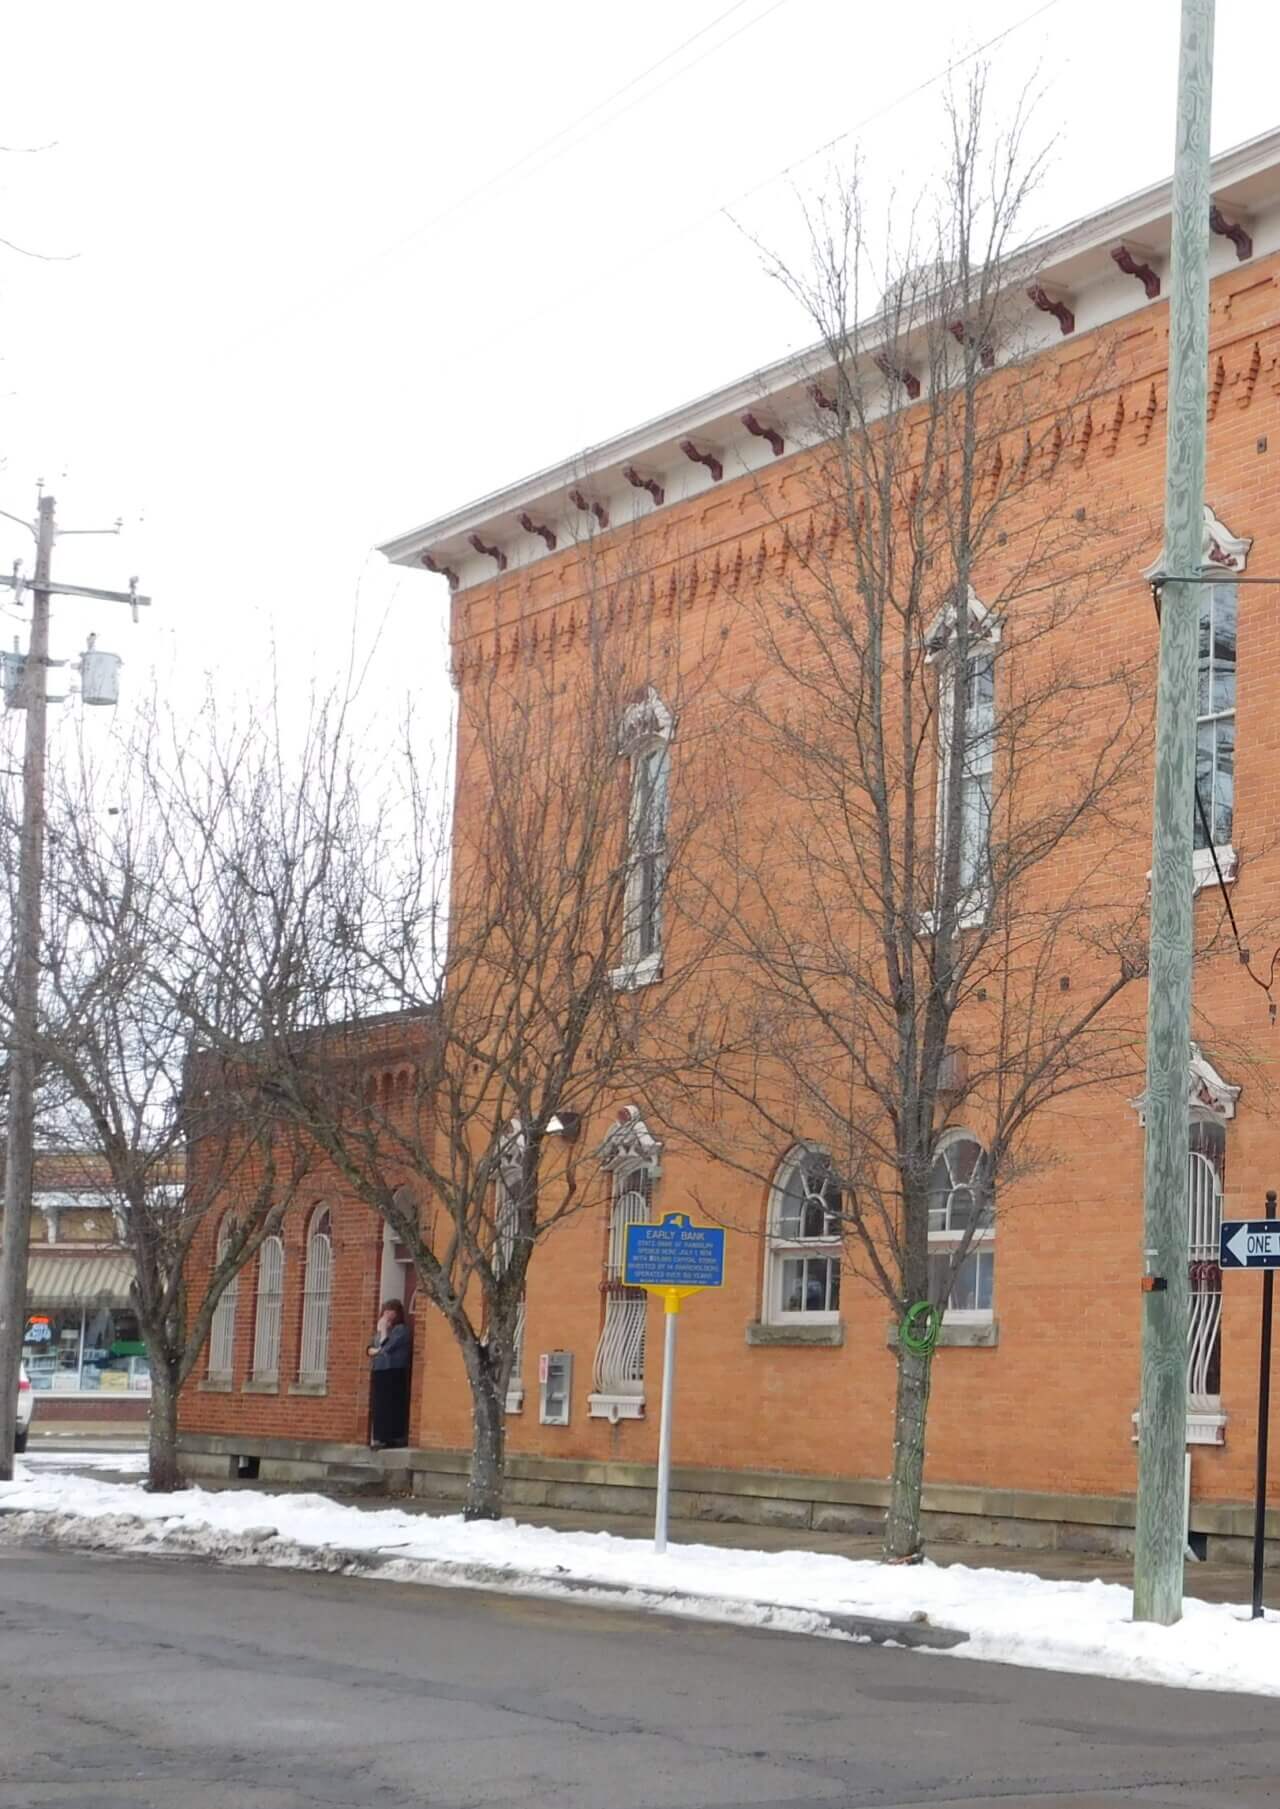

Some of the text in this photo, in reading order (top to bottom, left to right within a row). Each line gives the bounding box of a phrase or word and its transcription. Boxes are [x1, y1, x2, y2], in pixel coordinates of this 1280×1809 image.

[646, 1230, 705, 1241] EARLY BANK
[1247, 1235, 1272, 1253] ONE
